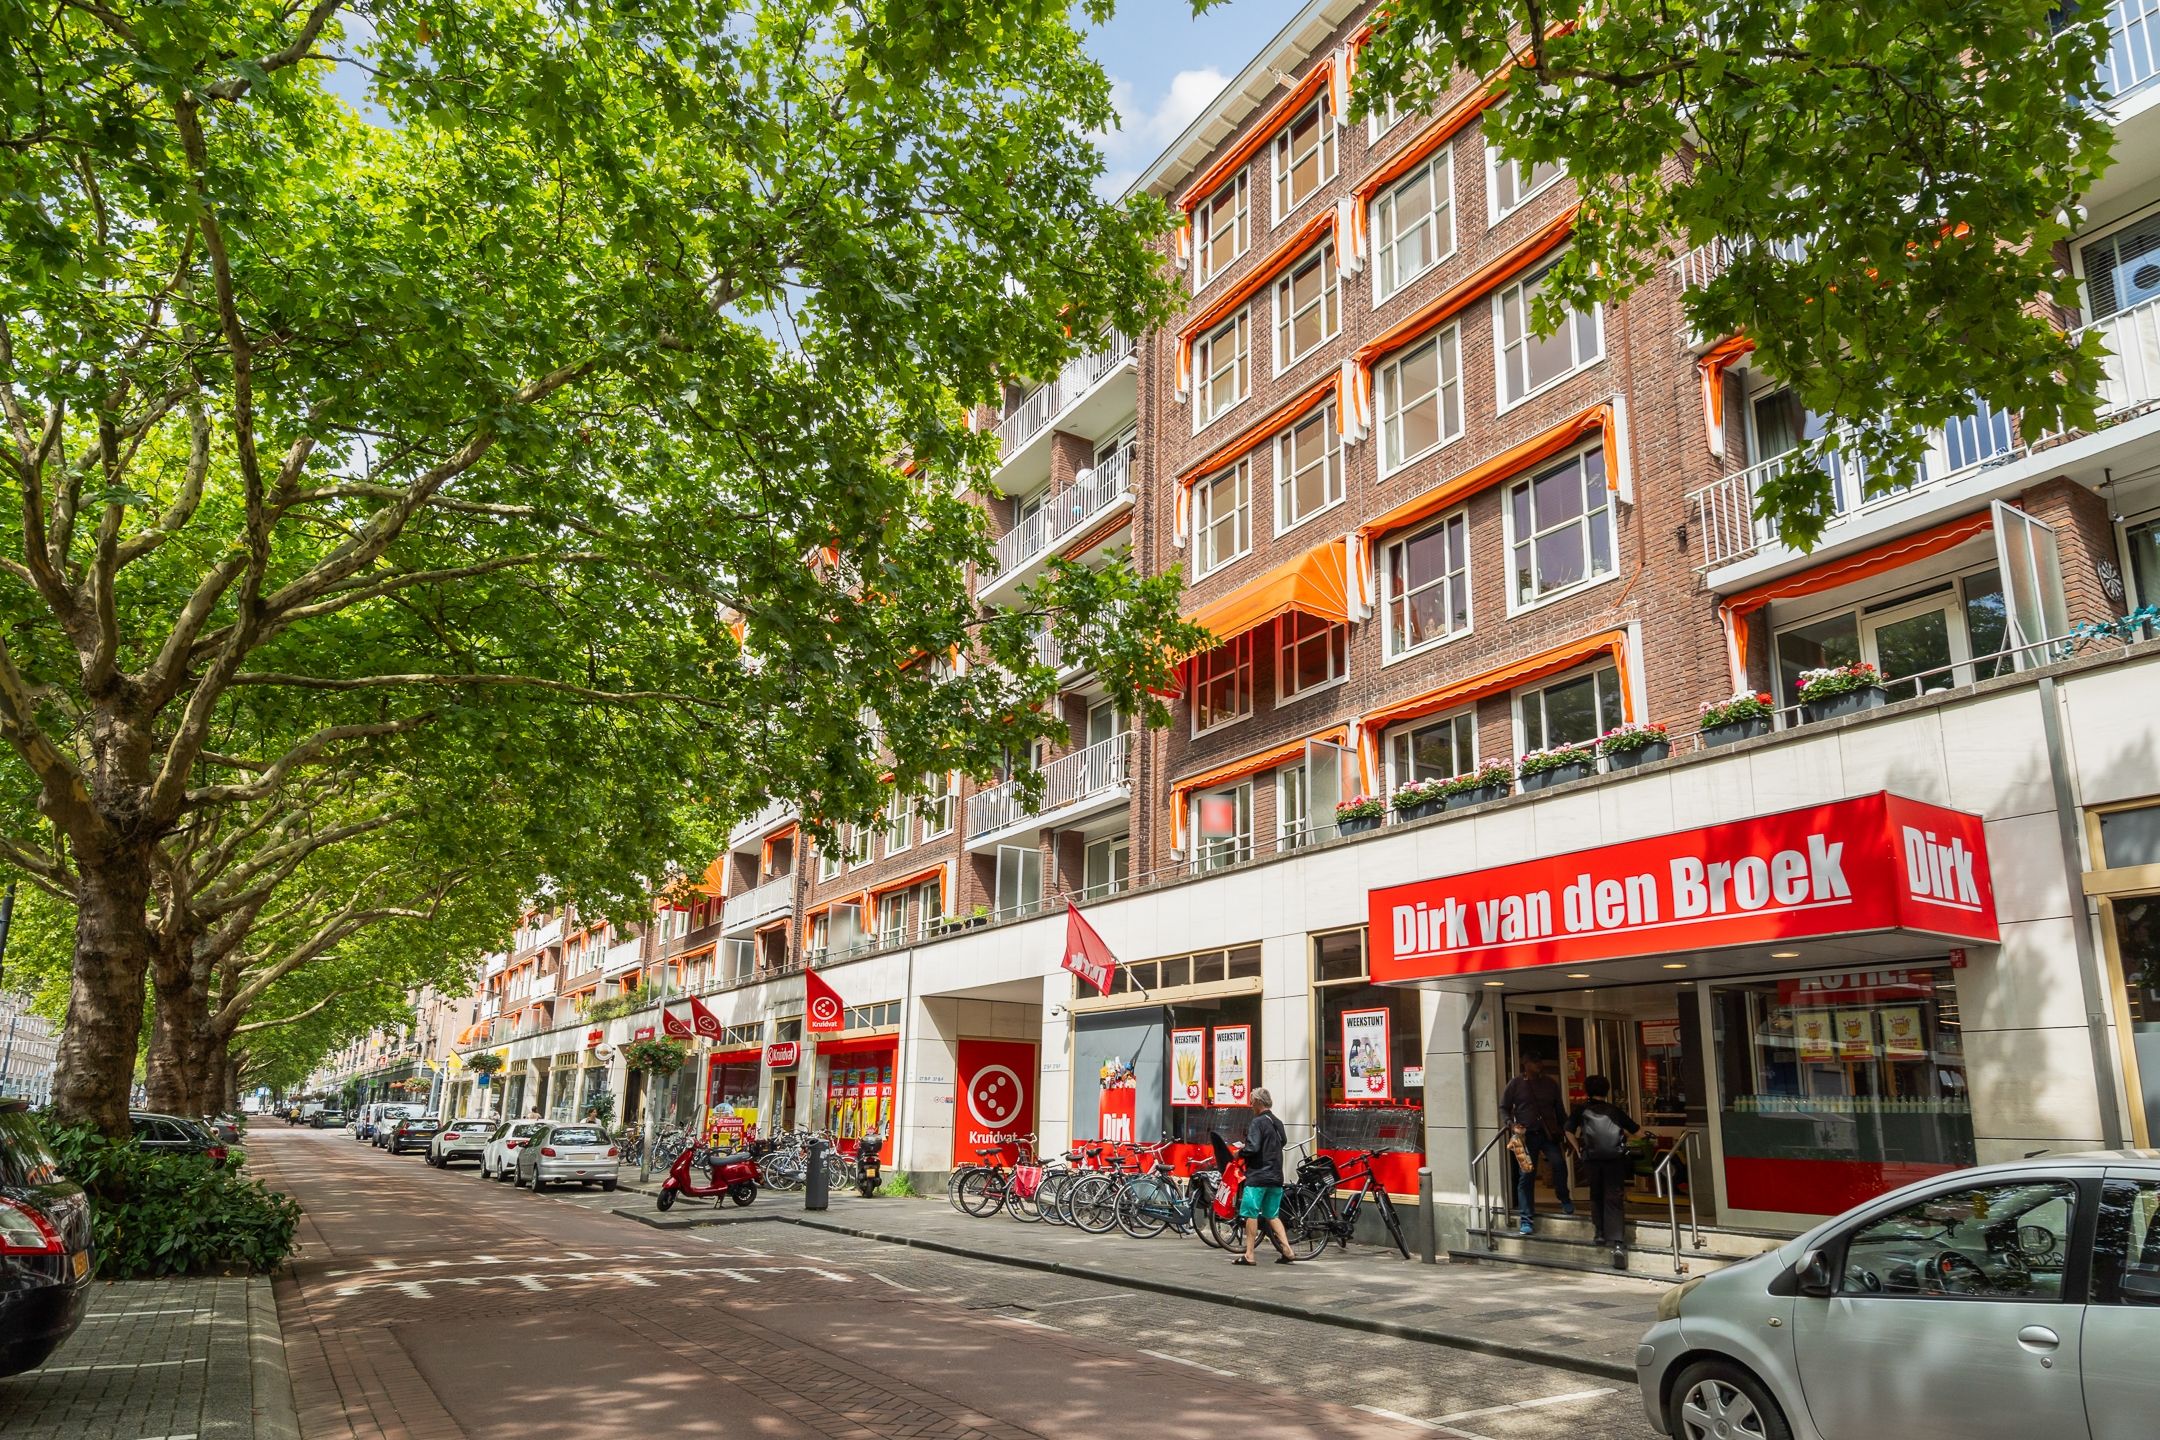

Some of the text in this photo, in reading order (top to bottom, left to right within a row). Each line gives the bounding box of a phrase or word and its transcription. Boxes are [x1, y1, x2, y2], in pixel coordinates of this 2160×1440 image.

[1902, 824, 1981, 905] Dirk
[1392, 833, 1852, 956] Dirk van den Broek
[812, 1020, 838, 1028] Kruidvat
[1346, 1015, 1384, 1028] WEEKSTUNT
[1174, 1034, 1201, 1045] WEEKSTUNT
[1216, 1031, 1246, 1042] WEEKSTUNT
[1475, 1040, 1484, 1048] 27
[772, 1047, 794, 1061] Kruidvat
[1102, 1113, 1131, 1142] Dirk
[969, 1130, 1018, 1145] Kruidvat
